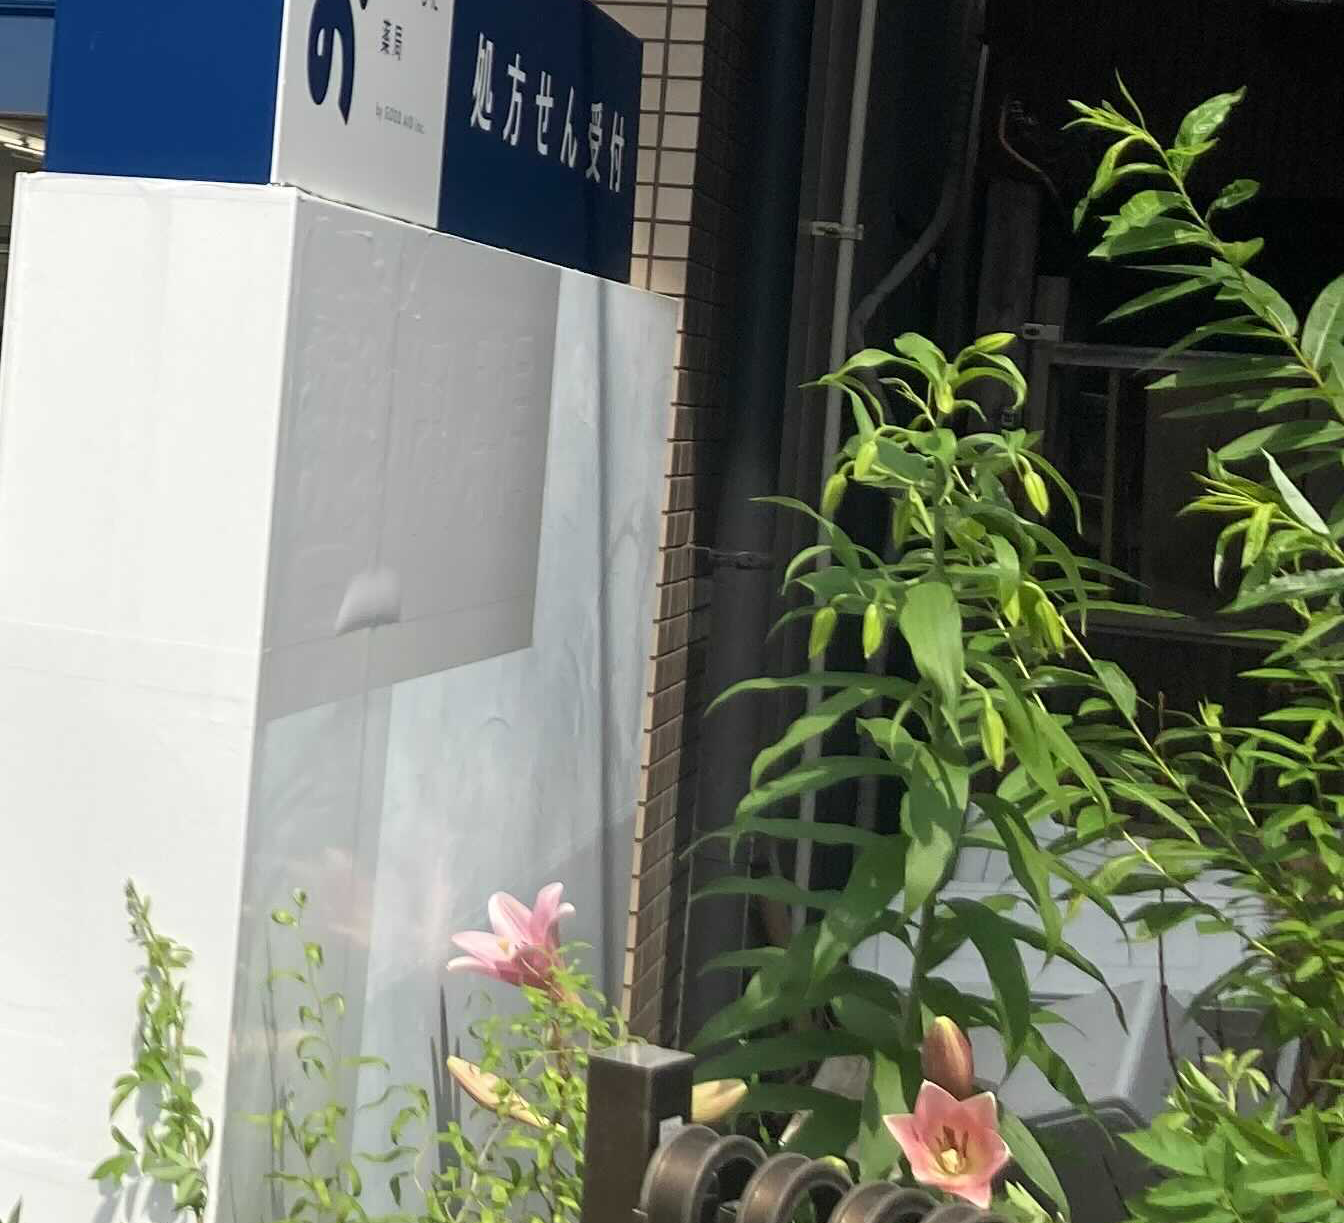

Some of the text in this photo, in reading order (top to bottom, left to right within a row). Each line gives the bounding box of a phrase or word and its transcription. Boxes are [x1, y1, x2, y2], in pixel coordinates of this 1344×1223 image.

[470, 32, 626, 193] 処方せん受付
